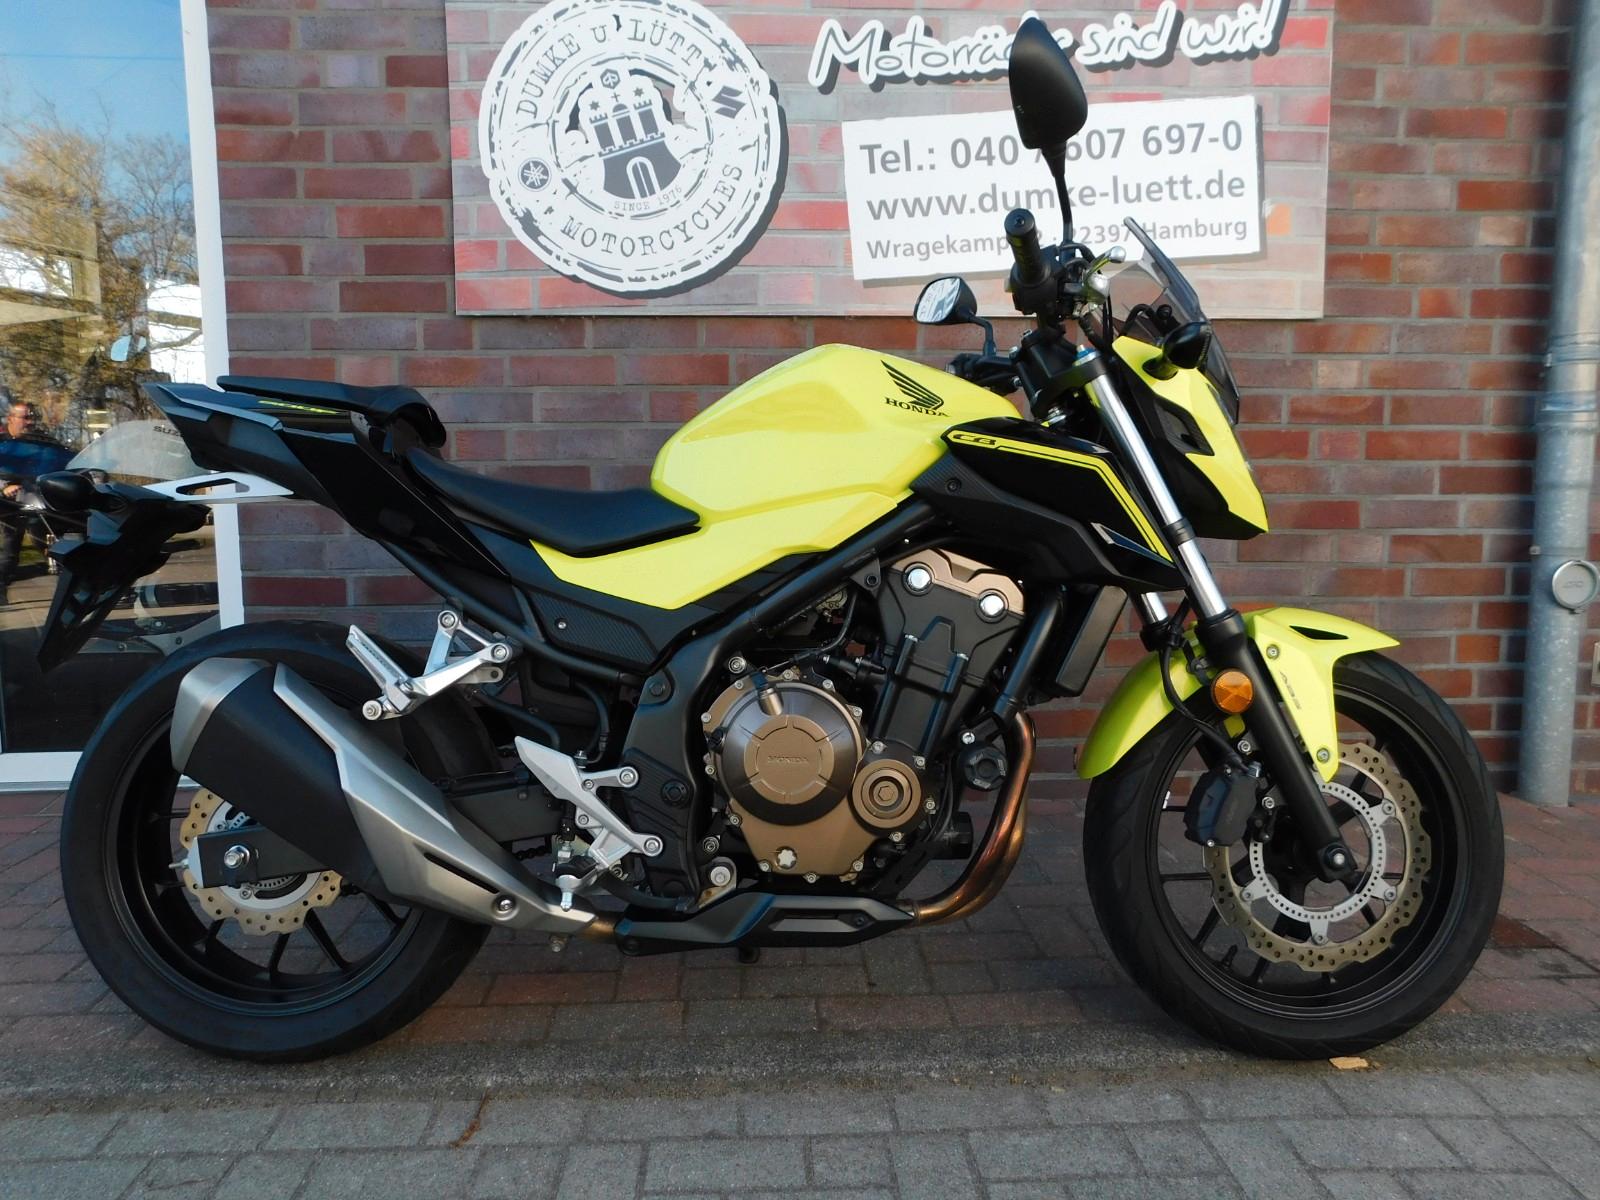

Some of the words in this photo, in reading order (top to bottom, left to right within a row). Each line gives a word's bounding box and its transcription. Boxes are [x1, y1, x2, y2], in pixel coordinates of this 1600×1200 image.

[1083, 5, 1174, 58] sind
[515, 32, 581, 119] DUMKE
[627, 18, 703, 66] LÜTT
[859, 139, 936, 174] Tel.:
[950, 135, 1019, 169] 040
[1142, 119, 1243, 157] 697-0
[561, 164, 743, 258] MOTORCYCLES
[613, 200, 650, 212] SINCE
[866, 234, 1010, 261] Wragekamp
[1144, 218, 1248, 242] Hamburg
[884, 397, 948, 418] HONDA
